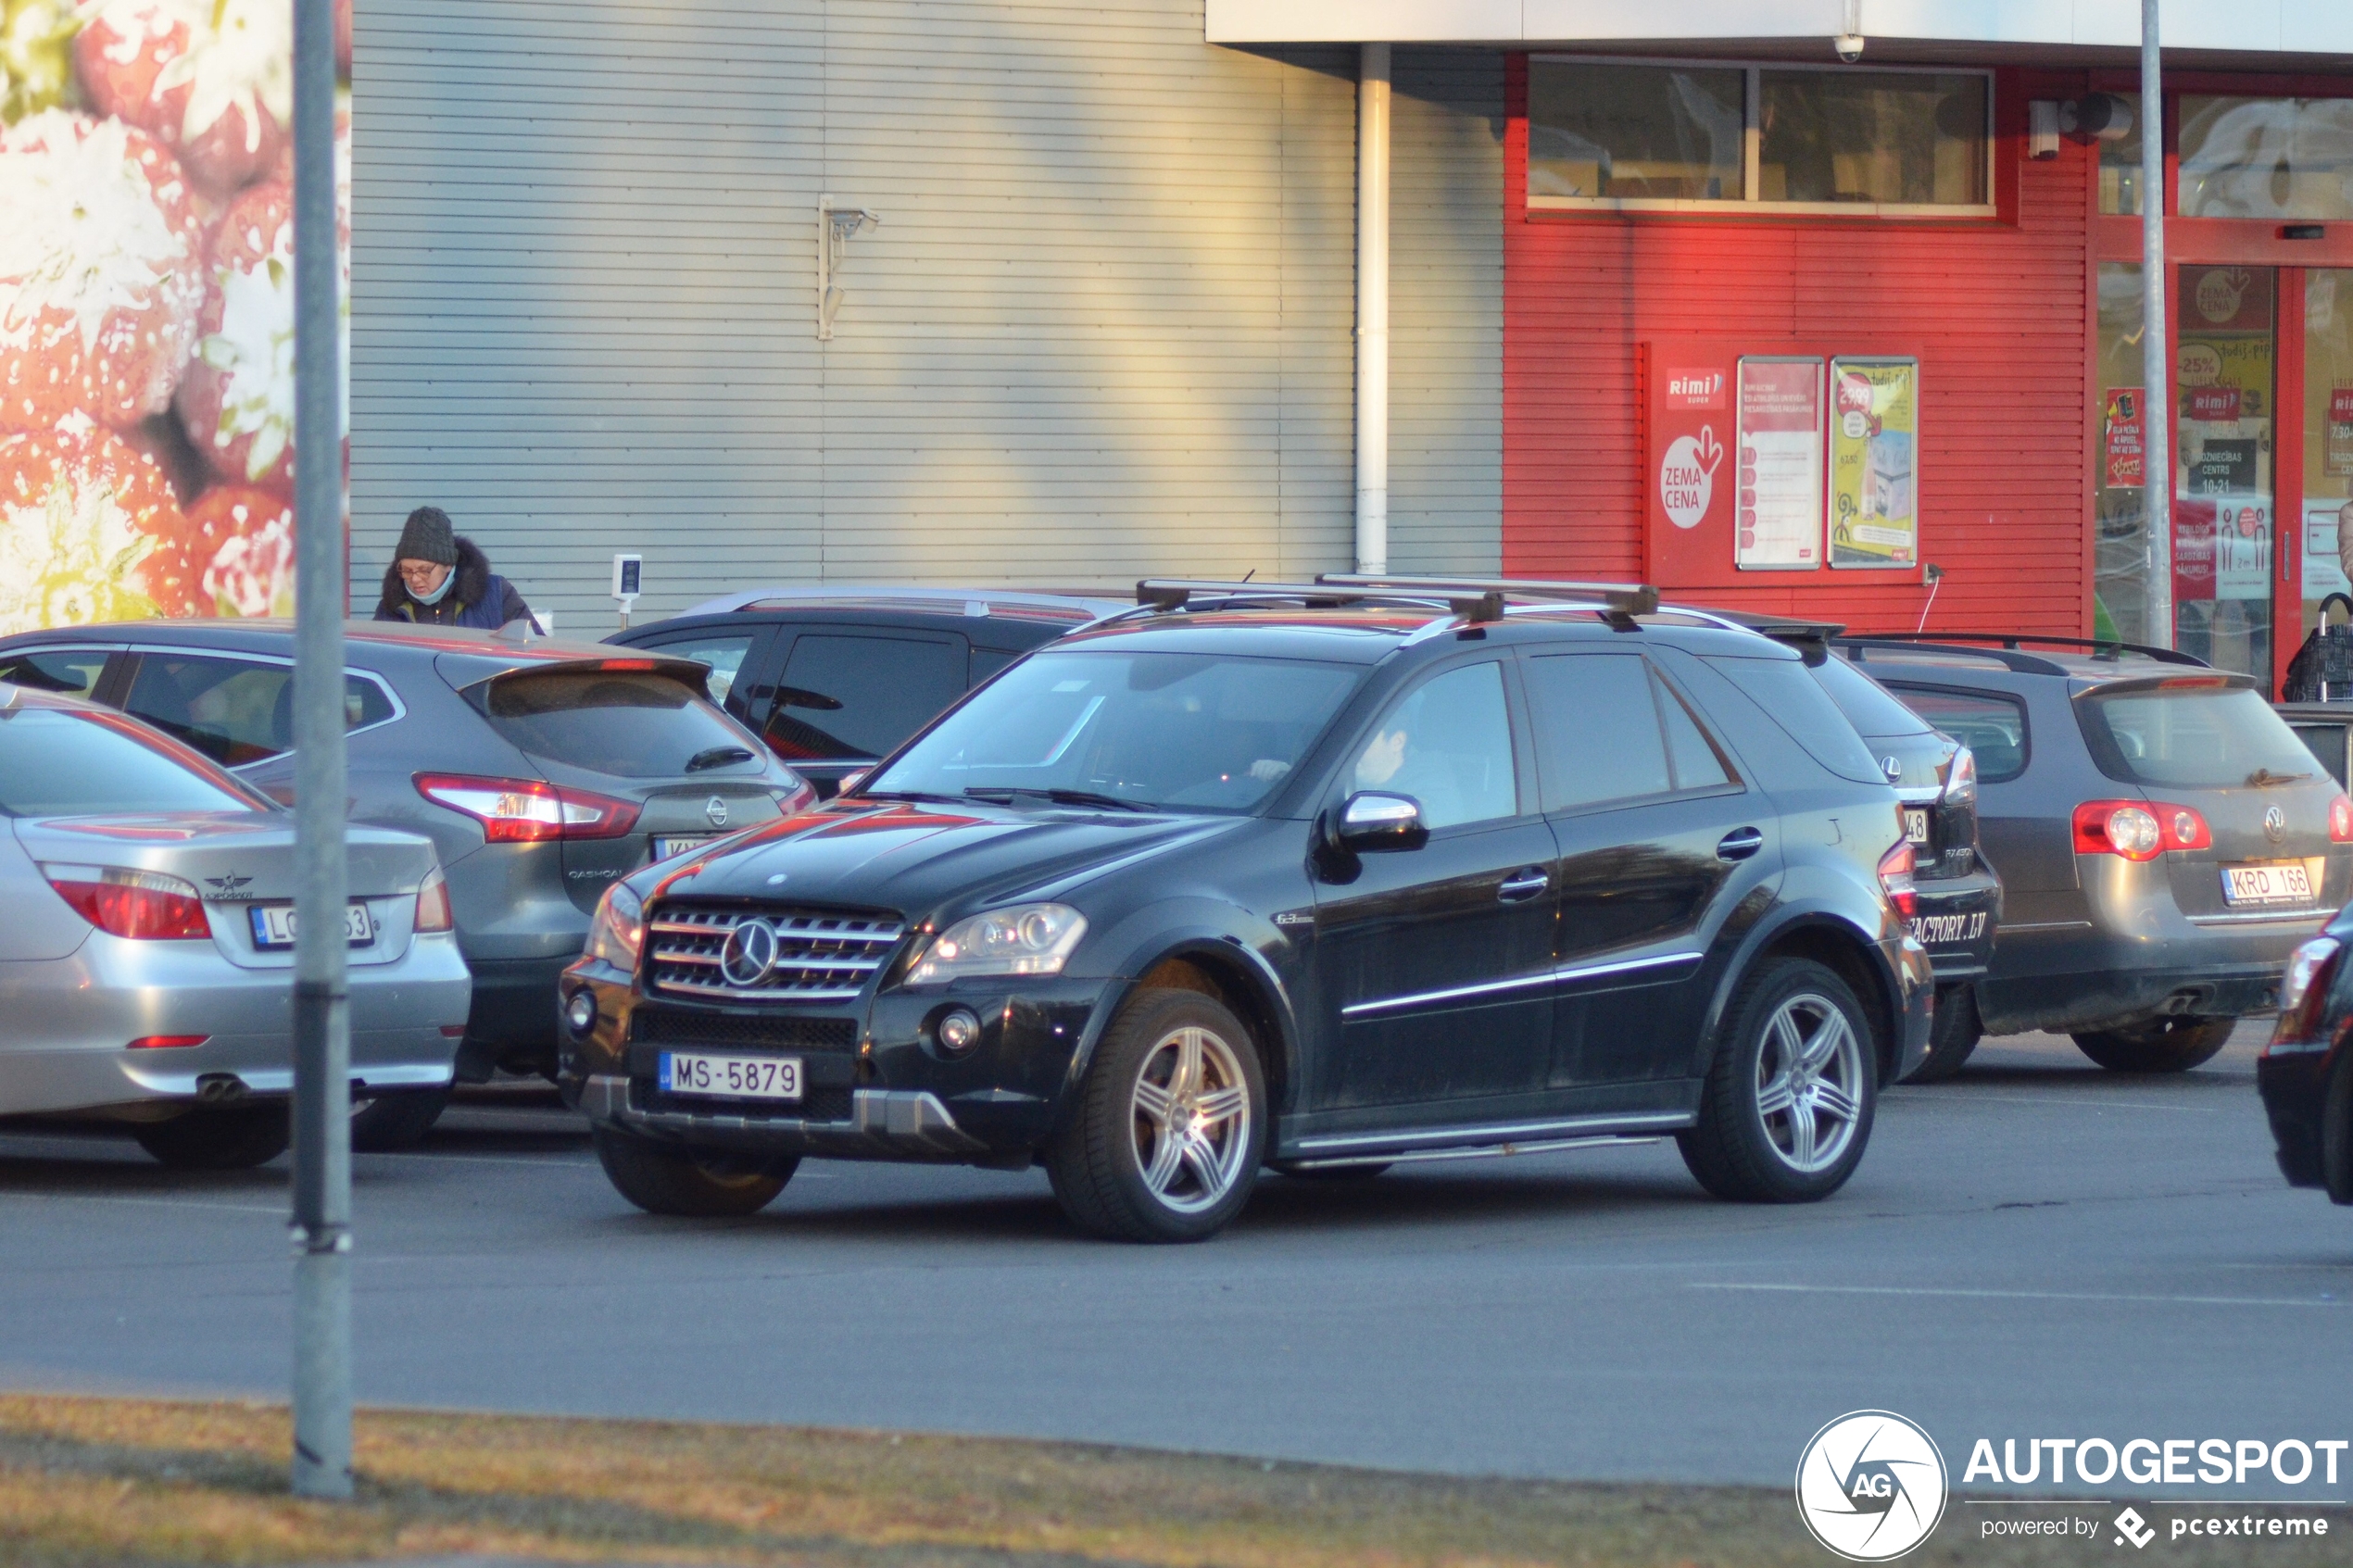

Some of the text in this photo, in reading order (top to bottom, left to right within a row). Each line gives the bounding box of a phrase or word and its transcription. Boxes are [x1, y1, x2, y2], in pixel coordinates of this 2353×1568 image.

[1669, 376, 1711, 395] Rimi
[1665, 468, 1702, 486] ZEMA
[2202, 465, 2230, 475] CENTRS
[2202, 479, 2230, 493] 10-21
[1665, 490, 1700, 508] CENA
[2232, 869, 2307, 896] KRD 166
[676, 1058, 796, 1093] MS-5879
